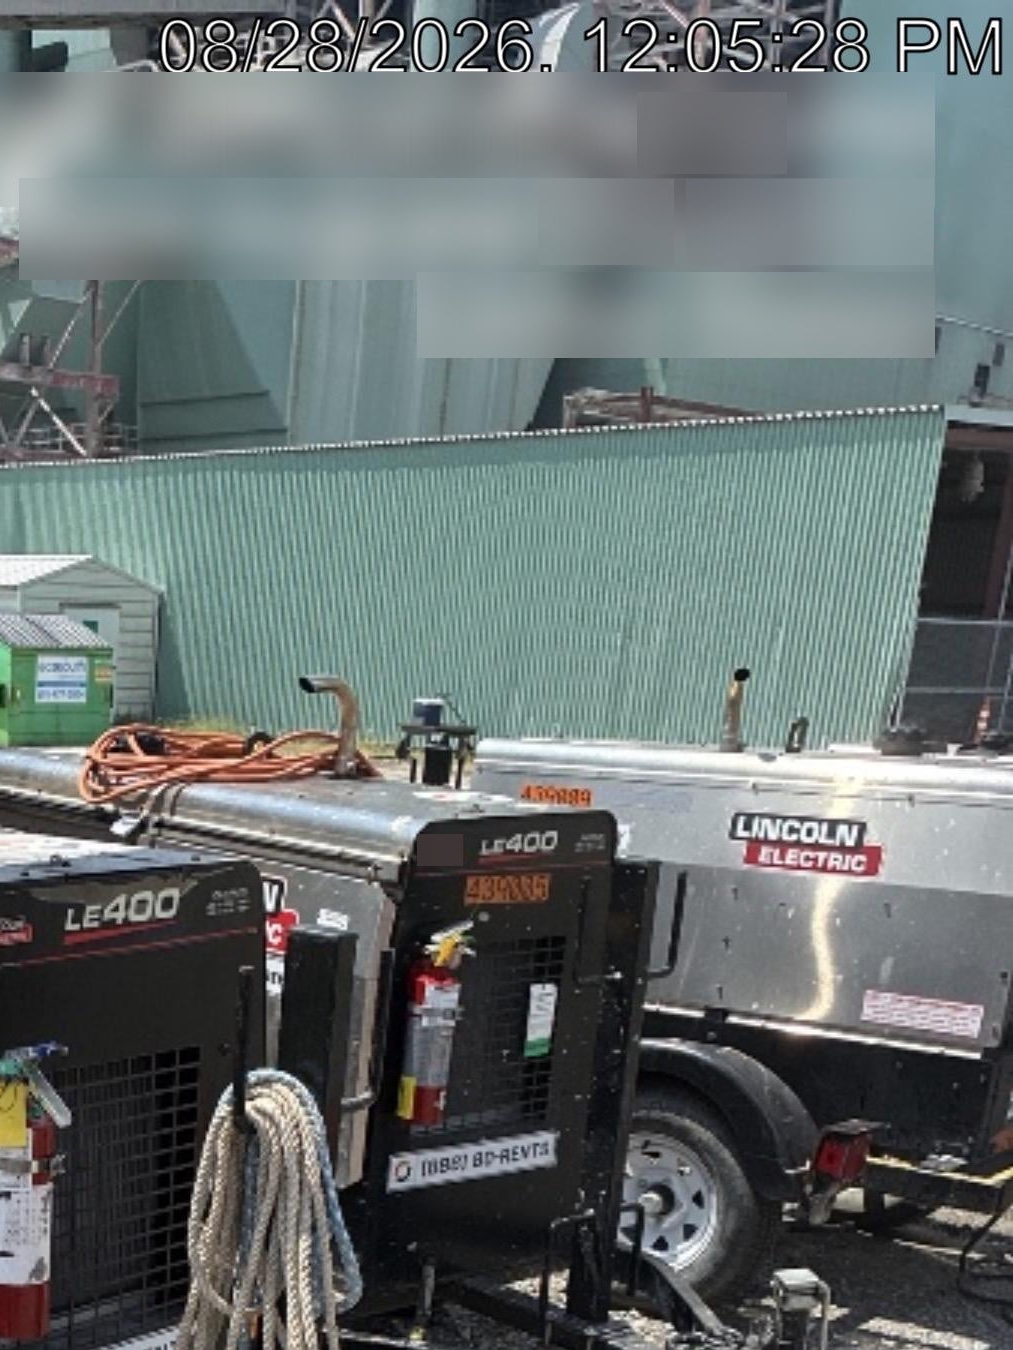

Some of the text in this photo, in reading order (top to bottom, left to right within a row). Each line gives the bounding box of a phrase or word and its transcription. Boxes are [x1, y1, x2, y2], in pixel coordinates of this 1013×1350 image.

[480, 829, 559, 856] LE400
[735, 815, 860, 847] LINCOLN
[758, 846, 868, 872] ELECTRIC
[64, 886, 181, 932] LE400
